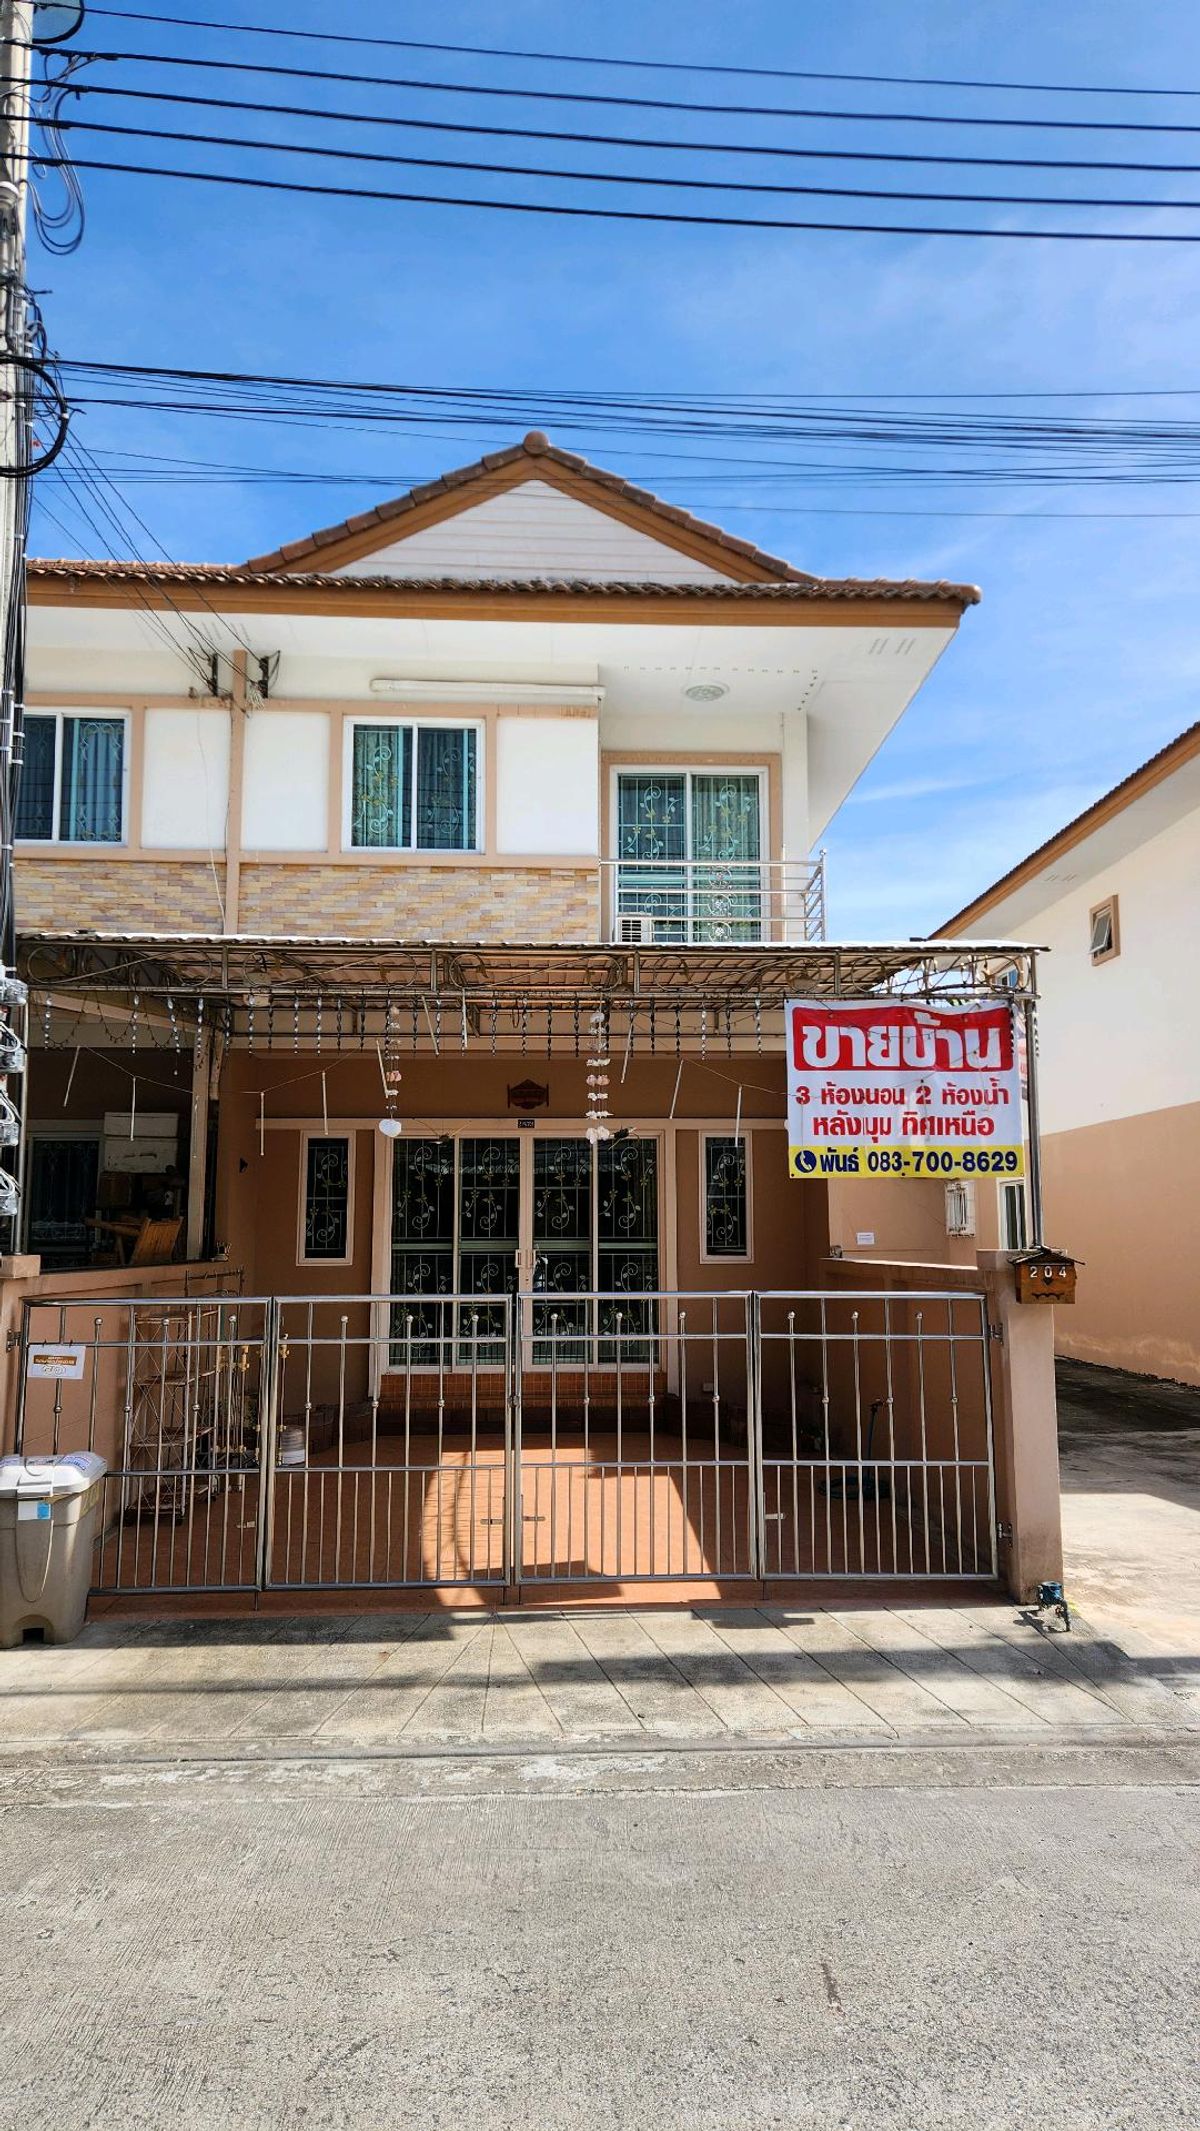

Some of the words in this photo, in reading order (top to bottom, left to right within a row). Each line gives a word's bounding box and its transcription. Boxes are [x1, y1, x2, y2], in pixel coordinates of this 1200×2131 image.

[802, 1011, 1001, 1069] ขายบ้าน
[795, 1085, 810, 1105] 3
[821, 1081, 905, 1105] ห้องนอน
[915, 1085, 932, 1105] 2
[941, 1078, 1009, 1106] ห้องน้ำ
[812, 1110, 892, 1144] หลังมุม
[902, 1110, 995, 1137] ทิศเหนือ
[820, 1147, 860, 1173] พันธ์
[867, 1151, 1018, 1173] 083-700-8629
[1030, 1265, 1067, 1278] 204
